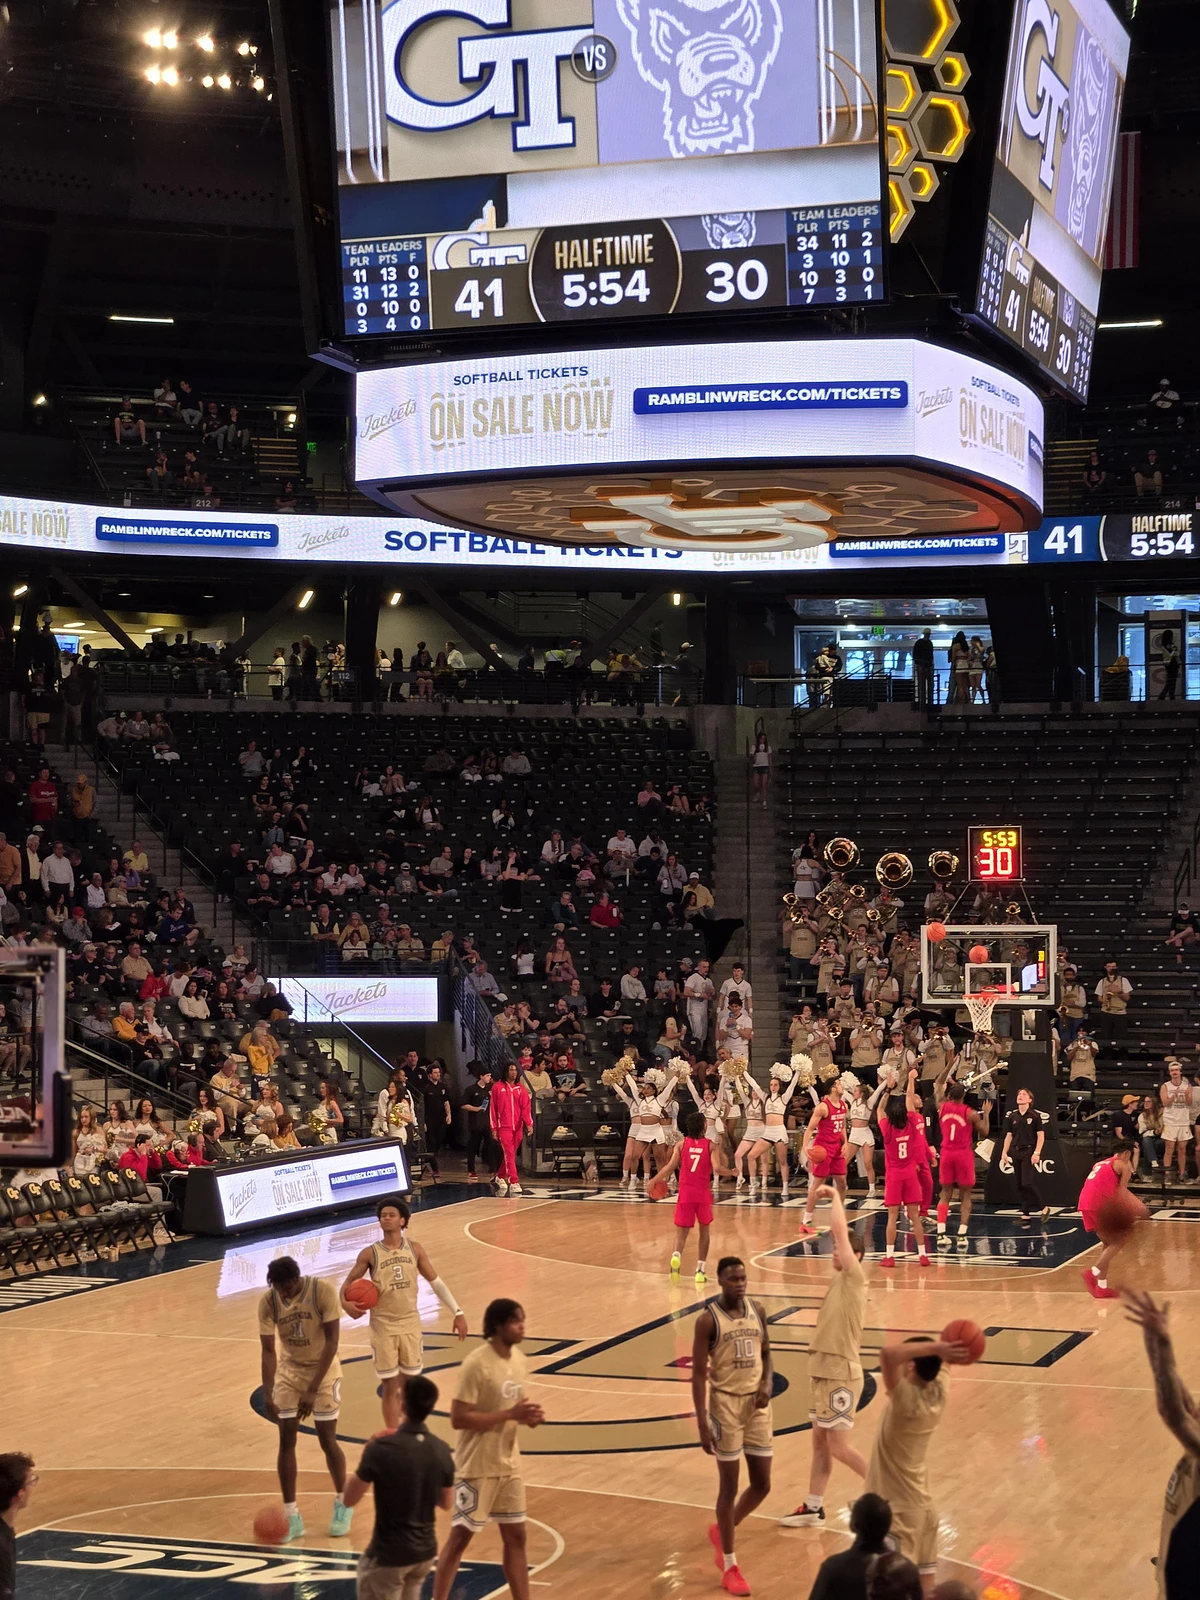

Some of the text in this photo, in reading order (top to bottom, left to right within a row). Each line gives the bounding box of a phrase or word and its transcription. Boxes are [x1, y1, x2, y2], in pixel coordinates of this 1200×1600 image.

[582, 43, 606, 72] VS
[792, 206, 879, 221] TEAM LEADERS
[796, 218, 871, 234] PLR PTS F
[344, 241, 422, 255] TEAM LEADERS
[797, 231, 873, 251] 34 11 2
[350, 252, 416, 267] PLR PTS F
[554, 234, 654, 269] HALFTIME
[802, 249, 871, 269] 3 10 1
[352, 265, 419, 283] 11 13 0
[705, 259, 769, 303] 30
[799, 267, 874, 286] 10 3 0
[352, 282, 419, 300] 31 12 2
[454, 278, 504, 319] 41
[563, 269, 650, 308] 5:54
[803, 284, 872, 304] 7 3 1
[356, 299, 421, 317] 0 10 0
[1005, 289, 1021, 332] 41
[357, 315, 421, 334] 3 4 0
[1029, 309, 1050, 353] 5:54
[1056, 333, 1072, 375] 30
[453, 366, 589, 386] SOFTBALL TICKETS
[647, 387, 902, 407] RAMBLINWRECK.COM/TICKETS
[971, 376, 1001, 398] SOFTBALL
[916, 386, 953, 418] Jackets
[360, 398, 417, 441] Jackets
[429, 387, 614, 446] ON SALE NOW
[959, 392, 977, 443] ON
[981, 404, 1004, 452] SALE
[195, 499, 212, 508] 212
[1164, 501, 1181, 509] 214
[0, 510, 70, 539] ALE NOW
[101, 523, 272, 540] RAMBLINWRECK.COM/TICKETS
[1131, 513, 1193, 533] HALFTIME
[297, 526, 350, 552] Jackets
[384, 530, 545, 555] SOFTBALL
[835, 537, 998, 552] RAMBLINWRECK.COM/TICKETS
[1043, 524, 1084, 555] 41
[1130, 532, 1195, 557] 5:54
[983, 831, 1017, 848] 5:53
[979, 848, 1013, 875] 30
[319, 981, 388, 1017] Jackets
[950, 1123, 956, 1141] 1
[898, 1142, 908, 1159] 8
[274, 1164, 312, 1177] SOFTBALL TICKETS
[690, 1154, 701, 1172] 7
[229, 1179, 258, 1218] Jackets
[272, 1176, 322, 1206] ON SALE NOW
[380, 1256, 413, 1270] GEORGIA
[392, 1265, 404, 1281] 3
[389, 1280, 411, 1291] TECH
[279, 1311, 313, 1326] GEORGIA
[288, 1338, 311, 1347] TECH
[734, 1338, 754, 1360] 10
[732, 1359, 756, 1370] TECH
